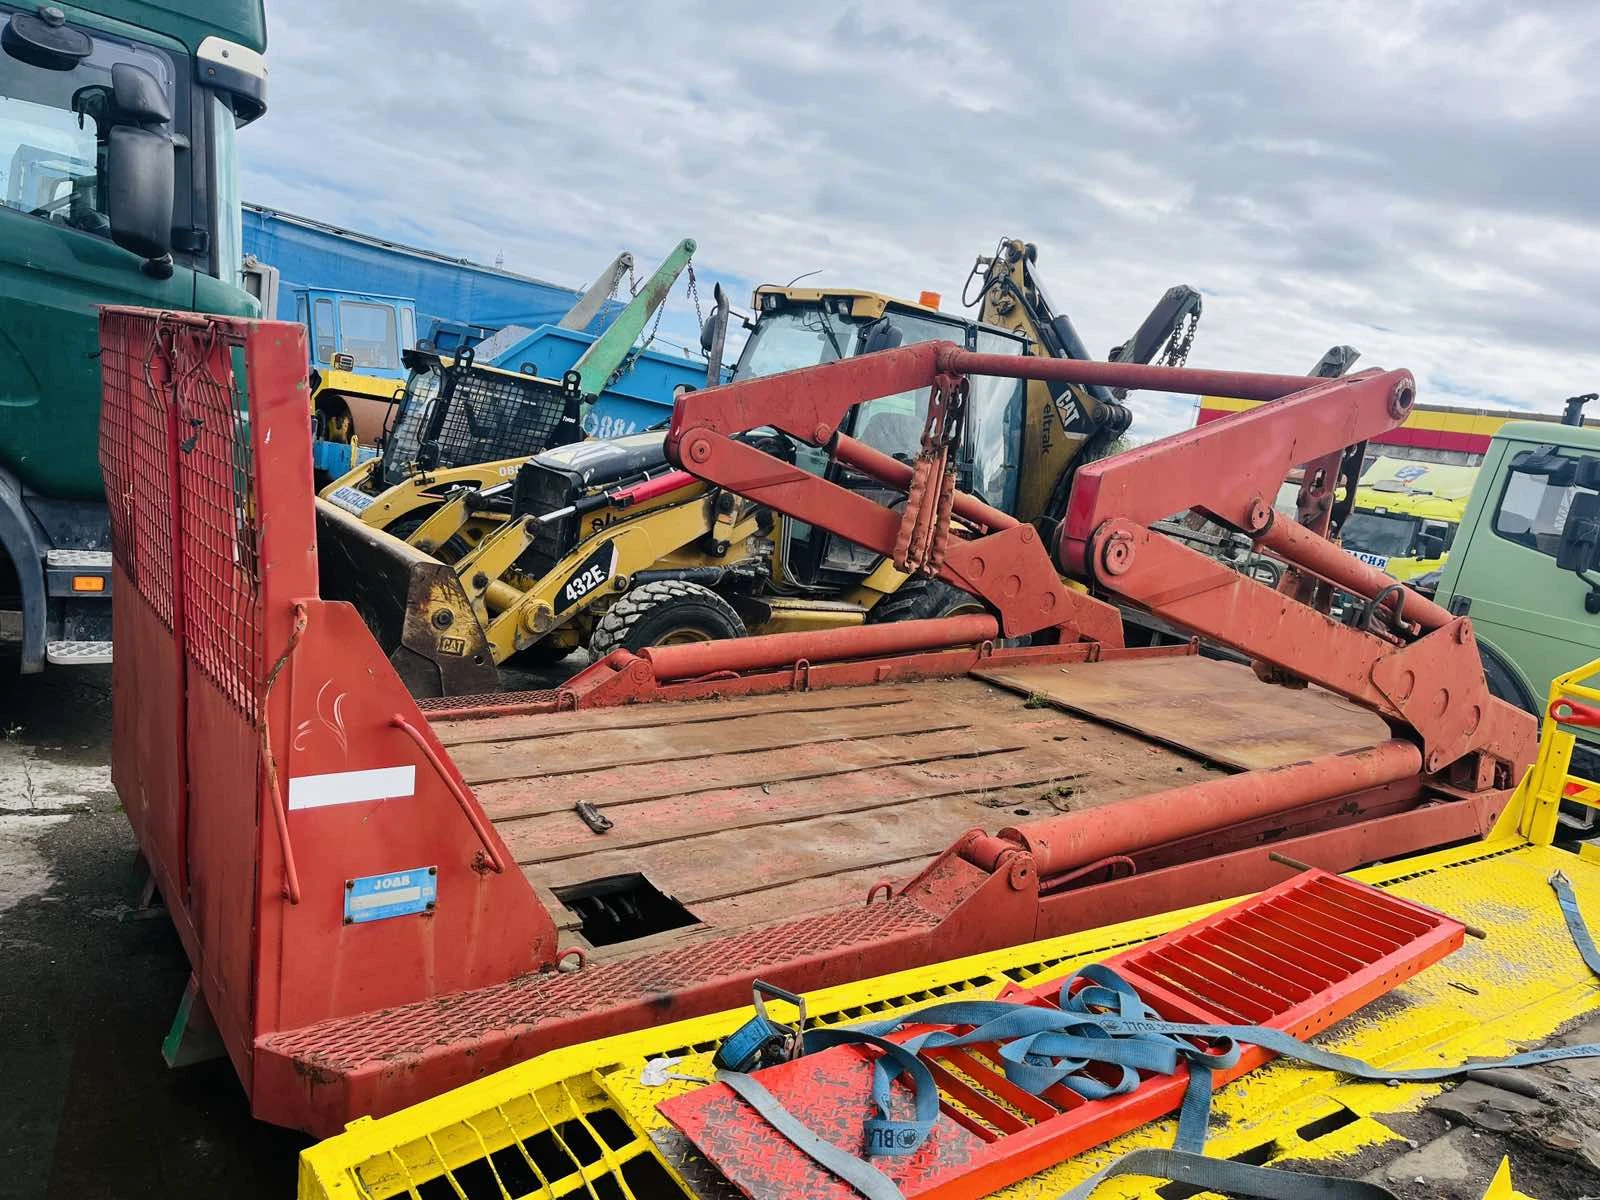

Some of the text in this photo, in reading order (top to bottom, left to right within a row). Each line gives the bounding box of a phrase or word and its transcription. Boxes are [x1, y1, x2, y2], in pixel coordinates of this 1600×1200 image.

[1056, 390, 1080, 427] CAT
[1042, 403, 1054, 454] eltrak
[566, 564, 605, 600] 432E
[442, 638, 464, 654] CAT
